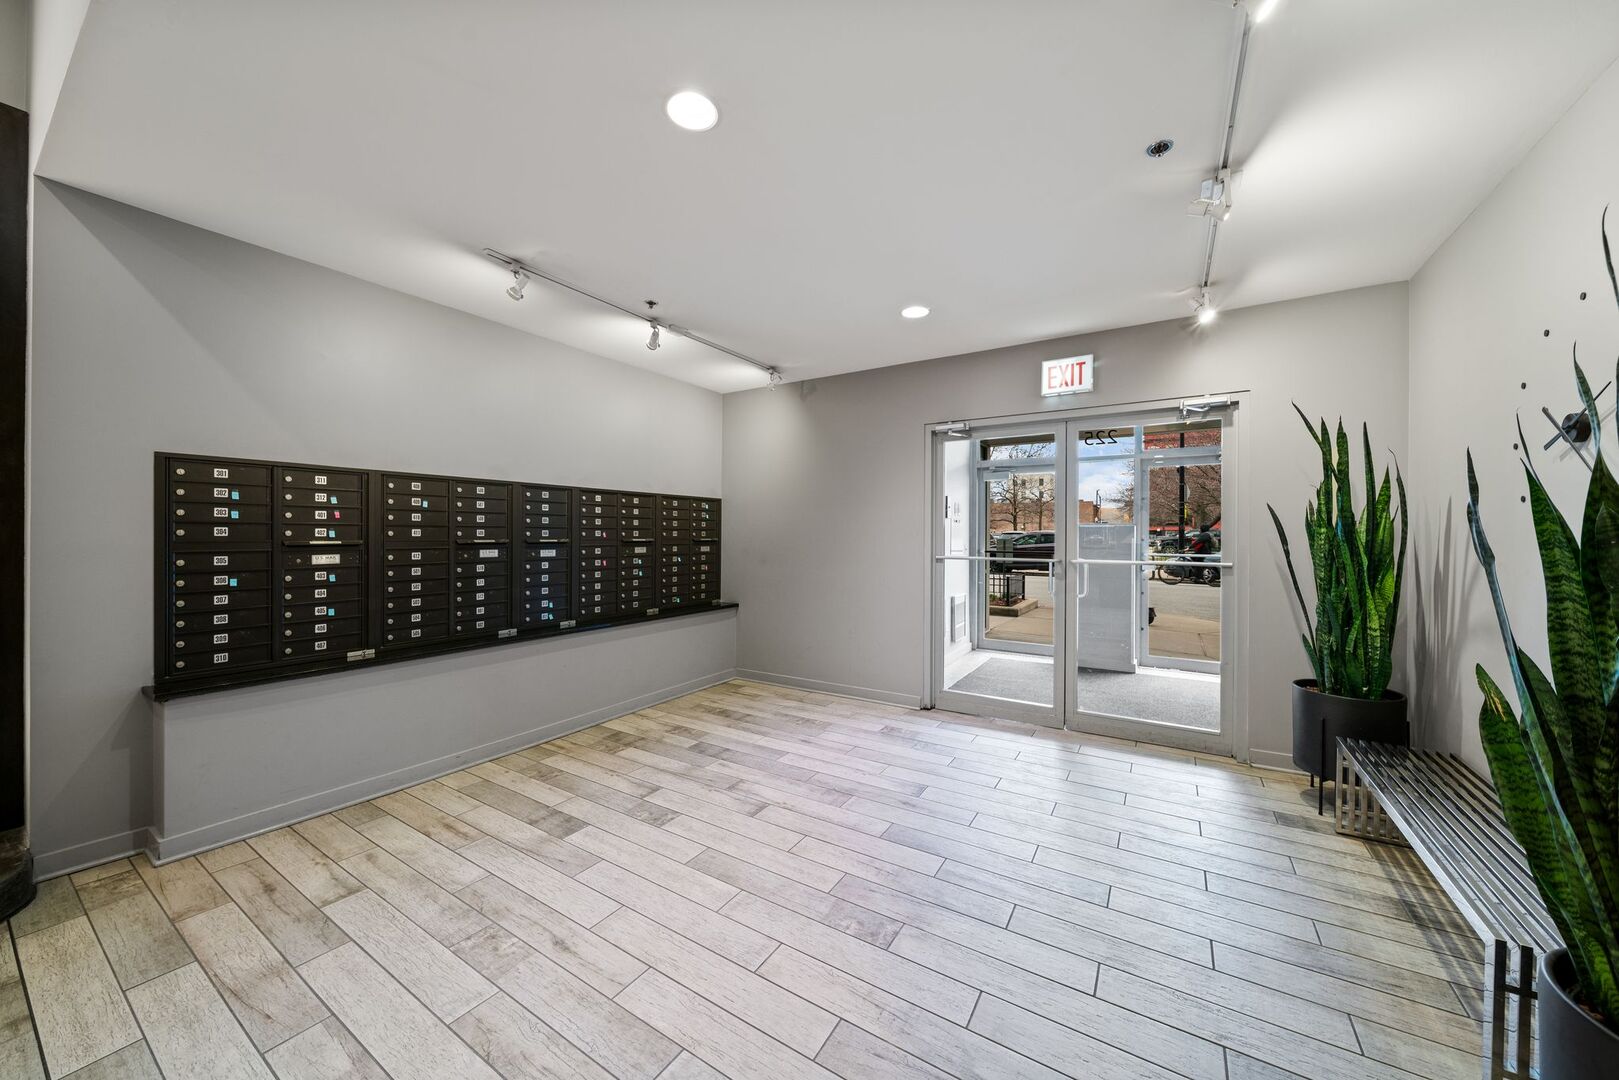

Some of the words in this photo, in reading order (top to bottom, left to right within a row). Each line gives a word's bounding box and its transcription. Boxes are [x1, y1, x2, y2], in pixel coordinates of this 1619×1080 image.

[1047, 361, 1086, 390] EXIT
[215, 469, 227, 478] 301
[215, 488, 227, 497] 302
[215, 508, 227, 517] 303
[215, 528, 227, 536] 304
[316, 529, 326, 537] 402
[215, 556, 227, 565] 305
[215, 596, 227, 604] 307
[215, 616, 227, 624] 308
[215, 635, 227, 644] 309
[215, 654, 227, 663] 310
